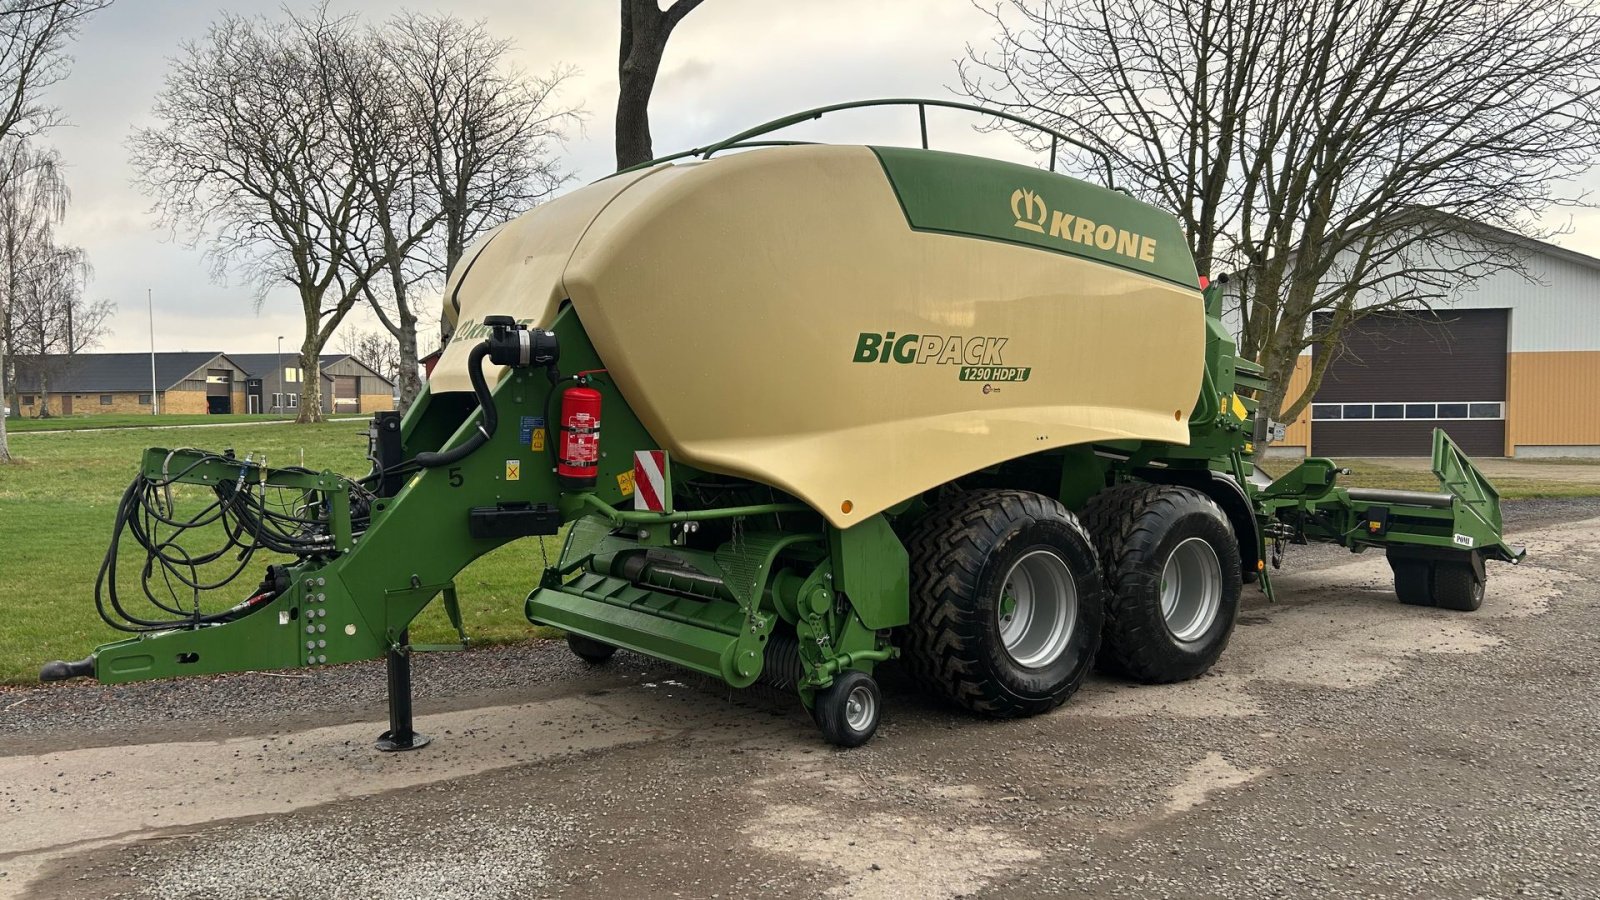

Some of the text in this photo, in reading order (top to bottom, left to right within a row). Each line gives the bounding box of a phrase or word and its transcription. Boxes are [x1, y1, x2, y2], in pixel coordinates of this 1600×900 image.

[1049, 210, 1157, 263] KRONE
[964, 368, 991, 381] 1290
[448, 467, 464, 488] 5
